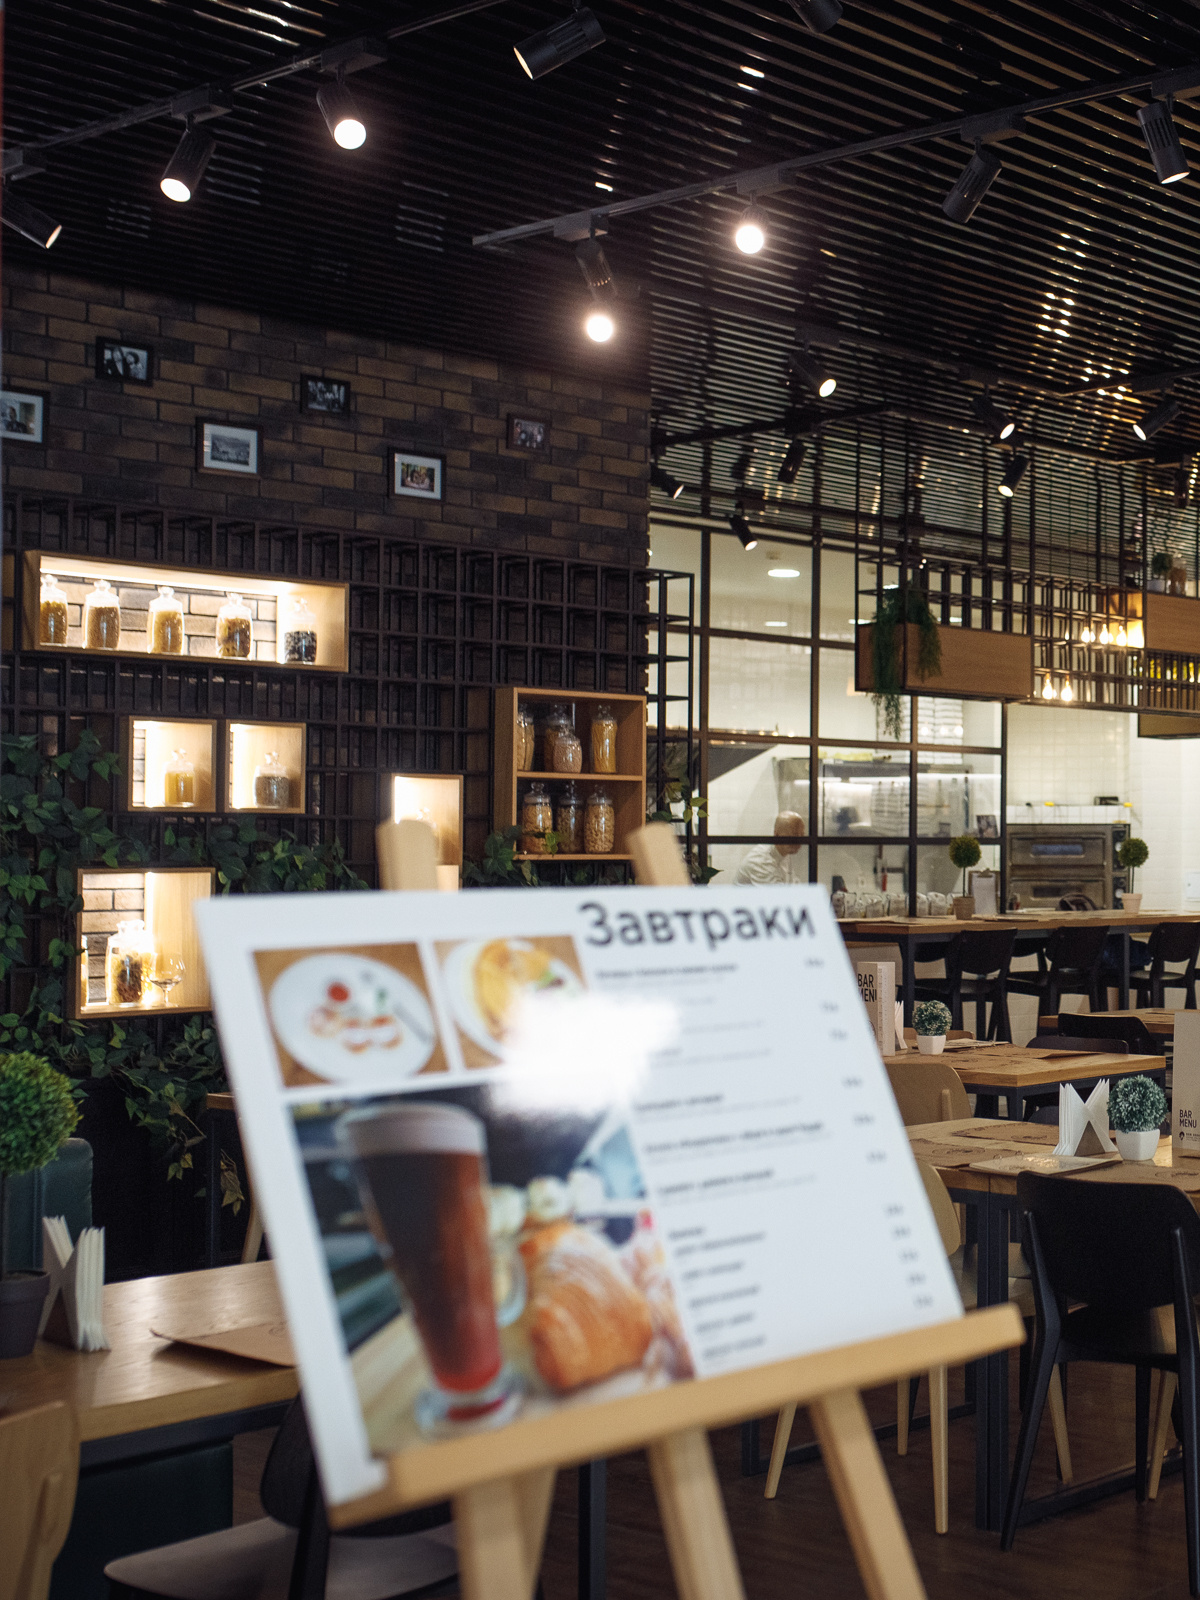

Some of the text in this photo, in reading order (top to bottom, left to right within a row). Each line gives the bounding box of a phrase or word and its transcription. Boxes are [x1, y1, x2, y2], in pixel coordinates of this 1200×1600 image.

[578, 899, 817, 952] Завтраки
[857, 973, 875, 988] BAR
[1179, 1109, 1193, 1119] BAR
[1179, 1118, 1198, 1129] MENU
